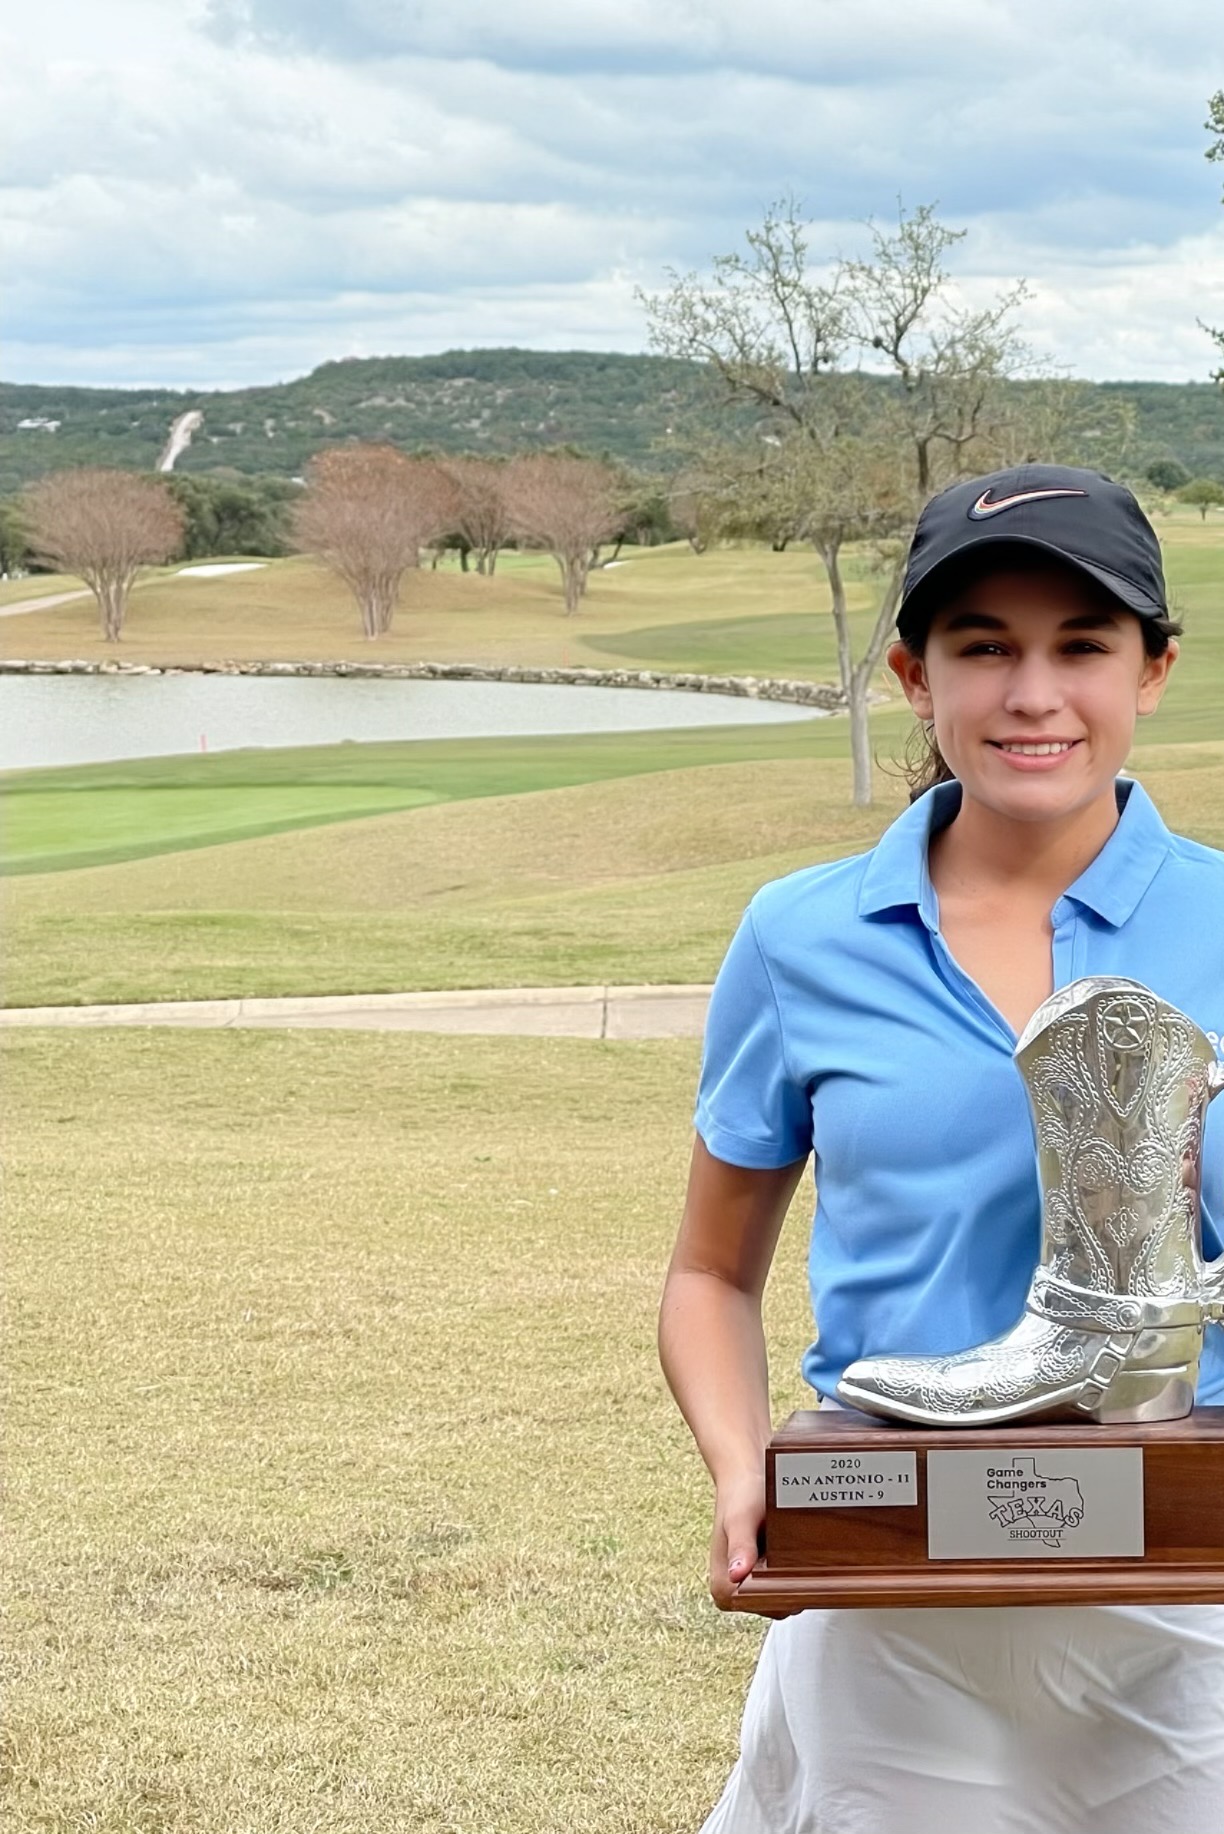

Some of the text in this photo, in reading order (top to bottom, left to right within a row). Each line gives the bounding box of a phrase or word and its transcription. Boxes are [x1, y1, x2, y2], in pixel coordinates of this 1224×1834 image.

[830, 1458, 861, 1469] 2020
[986, 1468, 1024, 1478] Game
[782, 1476, 811, 1486] SAN
[814, 1474, 884, 1485] ANTONIO
[897, 1474, 910, 1483] 11
[986, 1479, 1047, 1492] Changers
[809, 1491, 864, 1501] AUSTIN
[877, 1490, 884, 1500] 9
[989, 1496, 1084, 1528] TEXAS
[1009, 1529, 1064, 1538] SHOOTOUT
